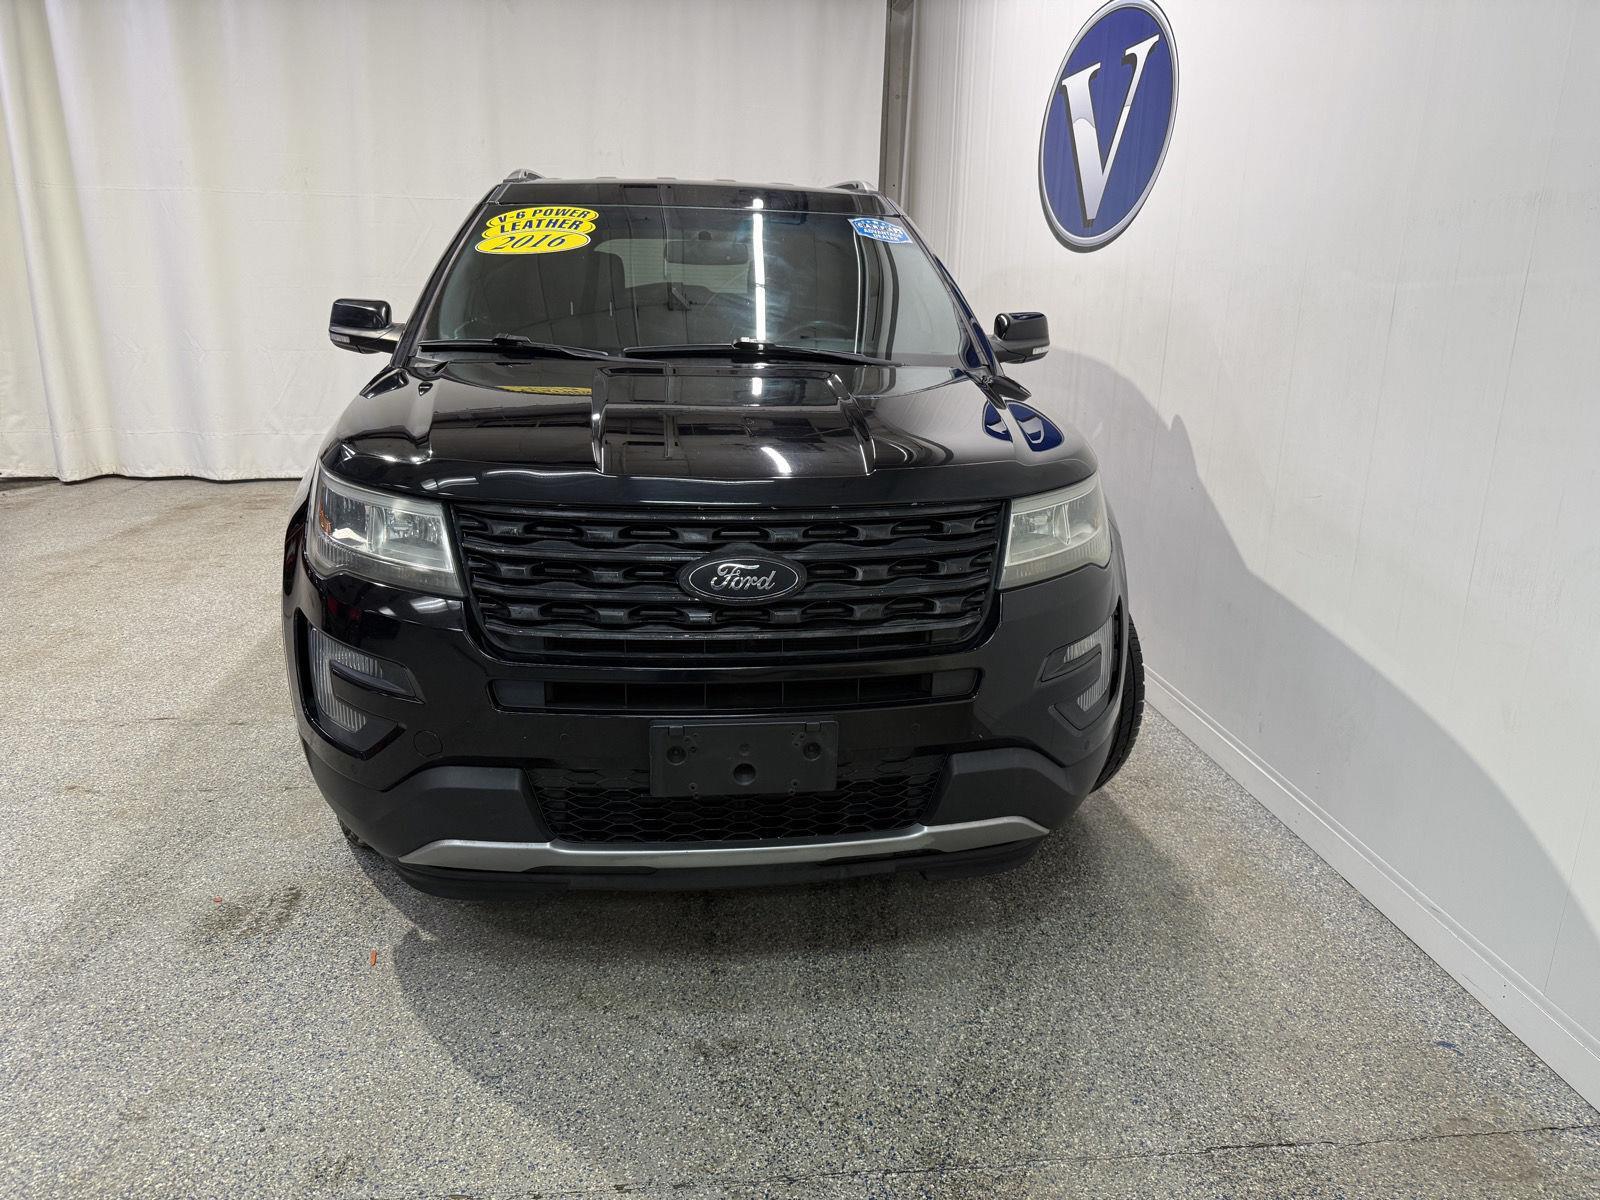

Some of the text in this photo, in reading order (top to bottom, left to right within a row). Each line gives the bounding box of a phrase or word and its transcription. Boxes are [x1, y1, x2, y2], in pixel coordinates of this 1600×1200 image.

[1061, 34, 1160, 220] V
[498, 208, 592, 223] V-6 POWER
[500, 218, 584, 234] LEATHER
[491, 233, 571, 250] 2016
[710, 563, 777, 590] Ford
